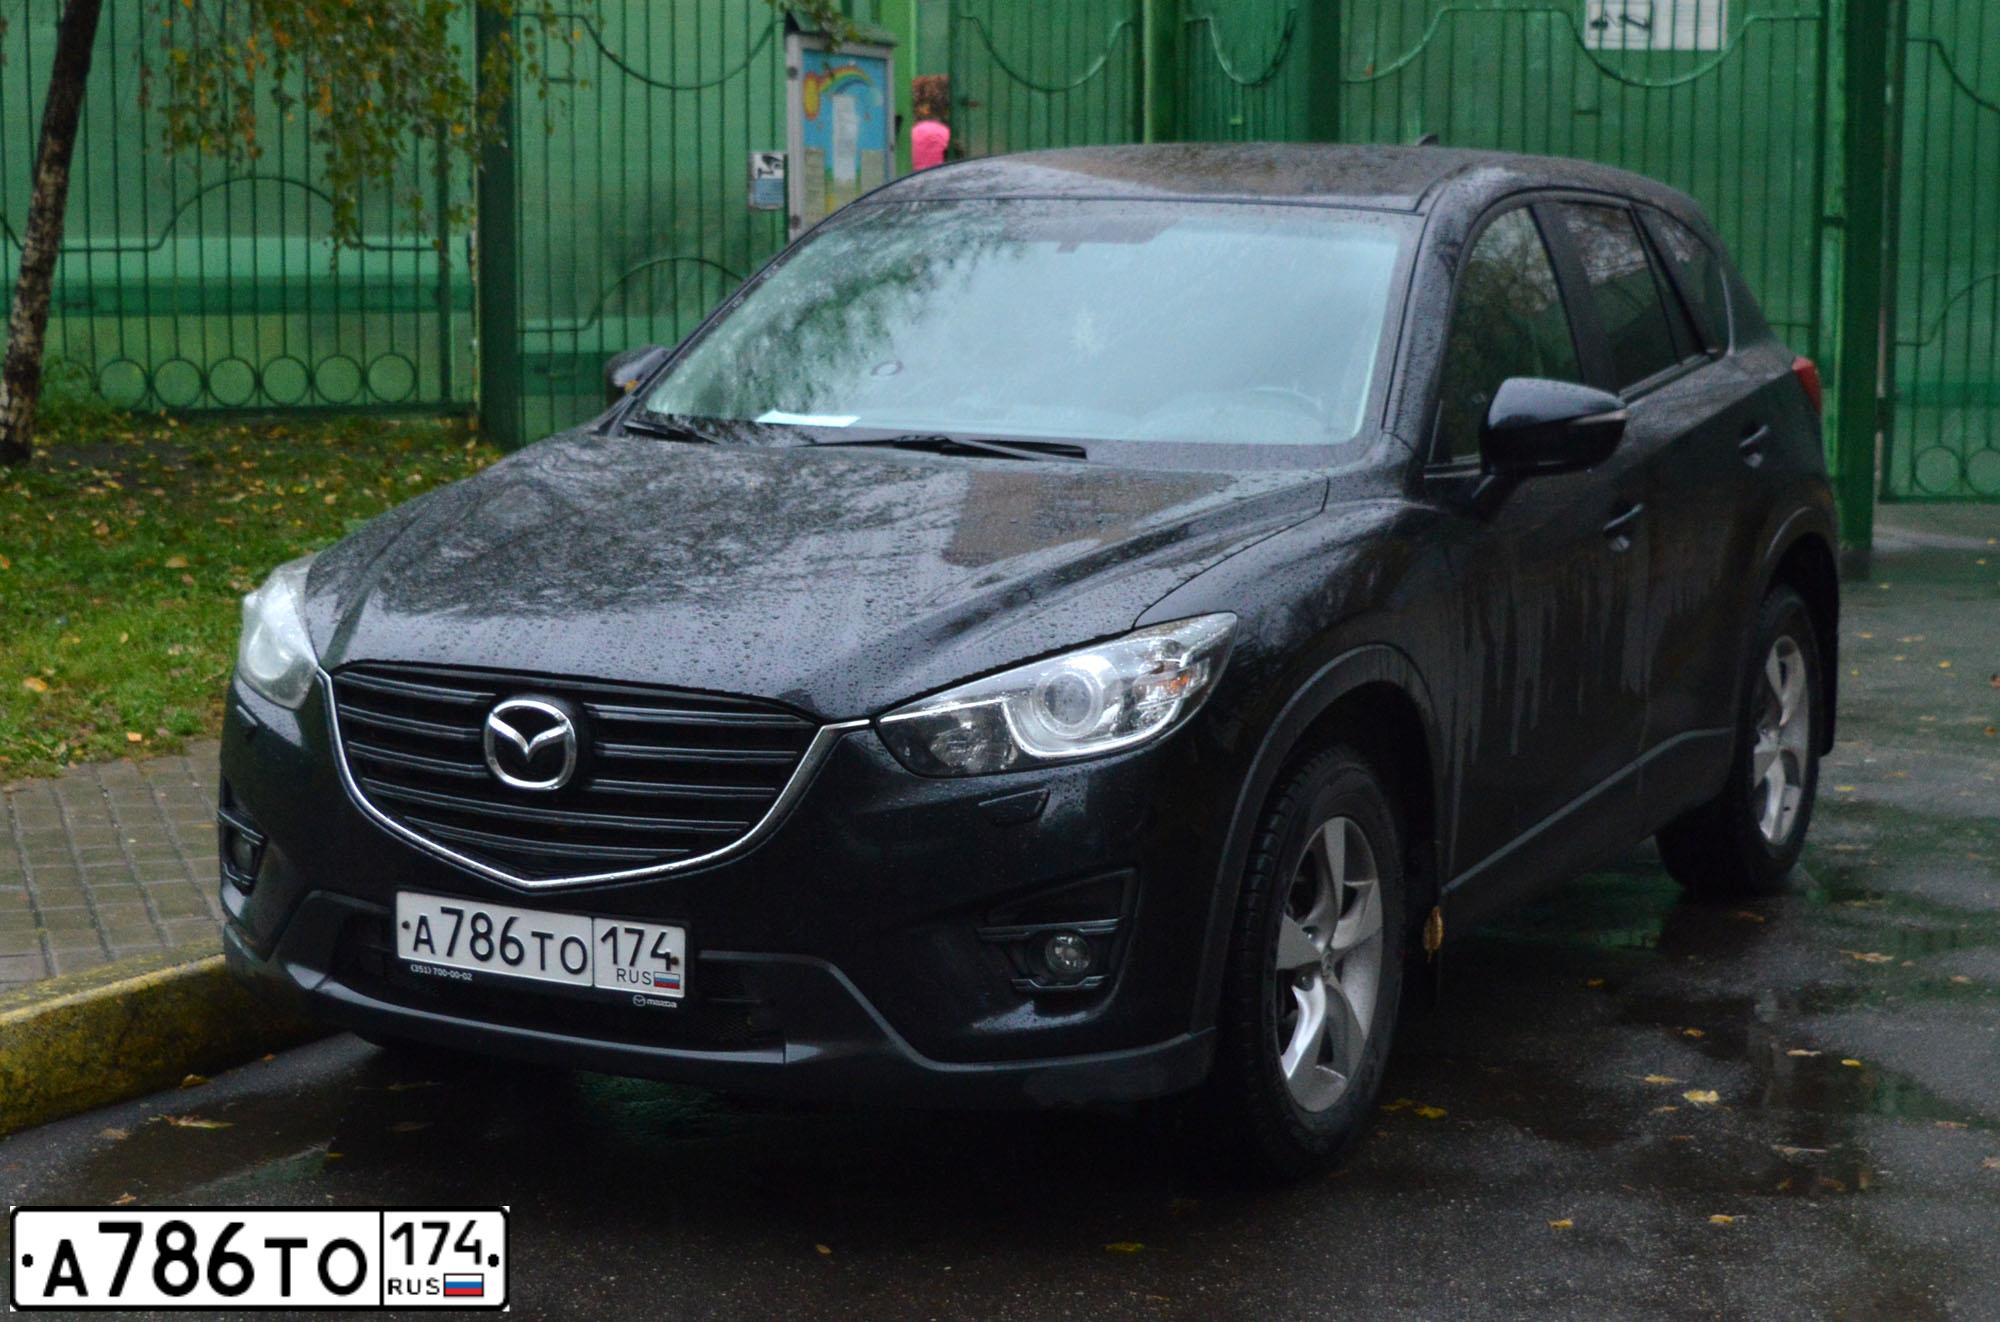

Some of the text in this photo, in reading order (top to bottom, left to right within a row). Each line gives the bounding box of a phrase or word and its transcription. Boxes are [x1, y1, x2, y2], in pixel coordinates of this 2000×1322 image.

[412, 905, 673, 976] A786TO 174
[616, 968, 652, 985] RUS
